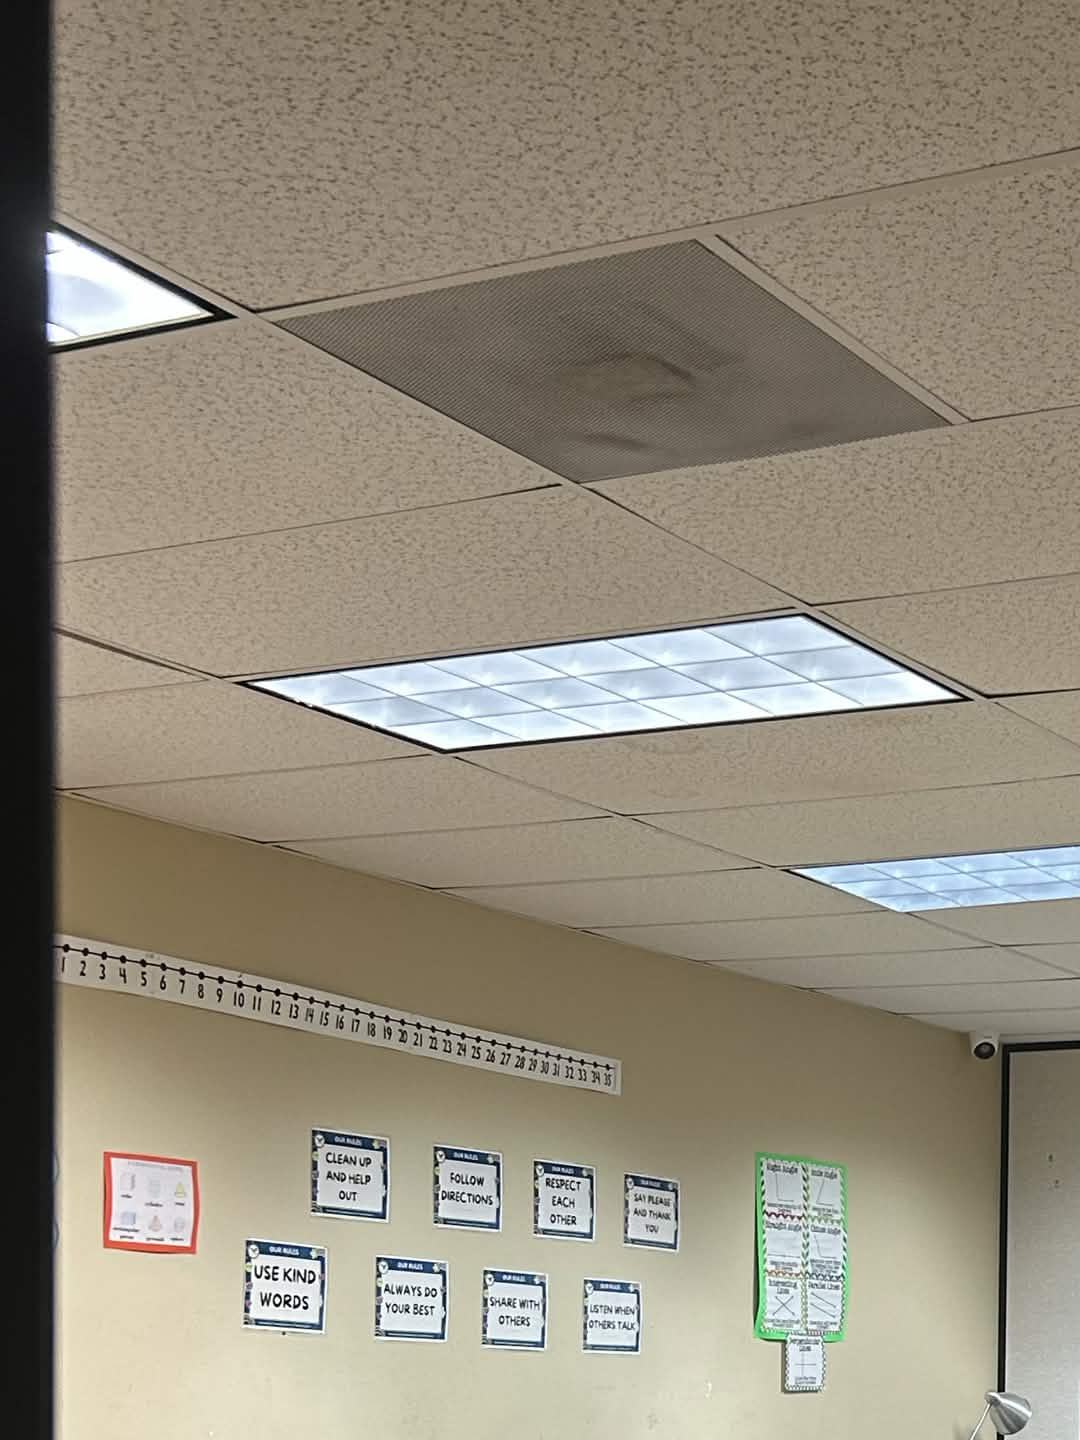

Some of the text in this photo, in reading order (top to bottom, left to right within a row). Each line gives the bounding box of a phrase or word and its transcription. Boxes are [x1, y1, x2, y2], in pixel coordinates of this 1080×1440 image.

[61, 957, 612, 1087] 1 2 3 4 5 6 7 8 9 10 11 12 13 14 15 16 17 18 19 20 21 22 23 24 25 26 27 28 29 30 31 32 33 34 35
[326, 1152, 372, 1168] CLEAN UP
[327, 1170, 372, 1185] AND HELP
[450, 1172, 485, 1187] FOLLOW
[545, 1177, 581, 1192] RESPECT
[338, 1190, 358, 1201] OUT
[441, 1190, 494, 1206] DIRECTIONS
[552, 1195, 575, 1208] EACH
[634, 1193, 671, 1207] SAY PLEASE
[549, 1214, 577, 1226] OTHER
[633, 1208, 671, 1221] AND THANK
[645, 1224, 659, 1233] YOU
[254, 1264, 316, 1285] USE KIND
[384, 1283, 438, 1298] ALWAYS DO
[260, 1291, 309, 1311] WORDS
[489, 1296, 540, 1311] SHARE WITH
[385, 1302, 435, 1316] YOUR BEST
[590, 1304, 635, 1315] LISTEN WHEN
[498, 1315, 531, 1327] OTHERS
[588, 1319, 636, 1331] OTHERS TALK
